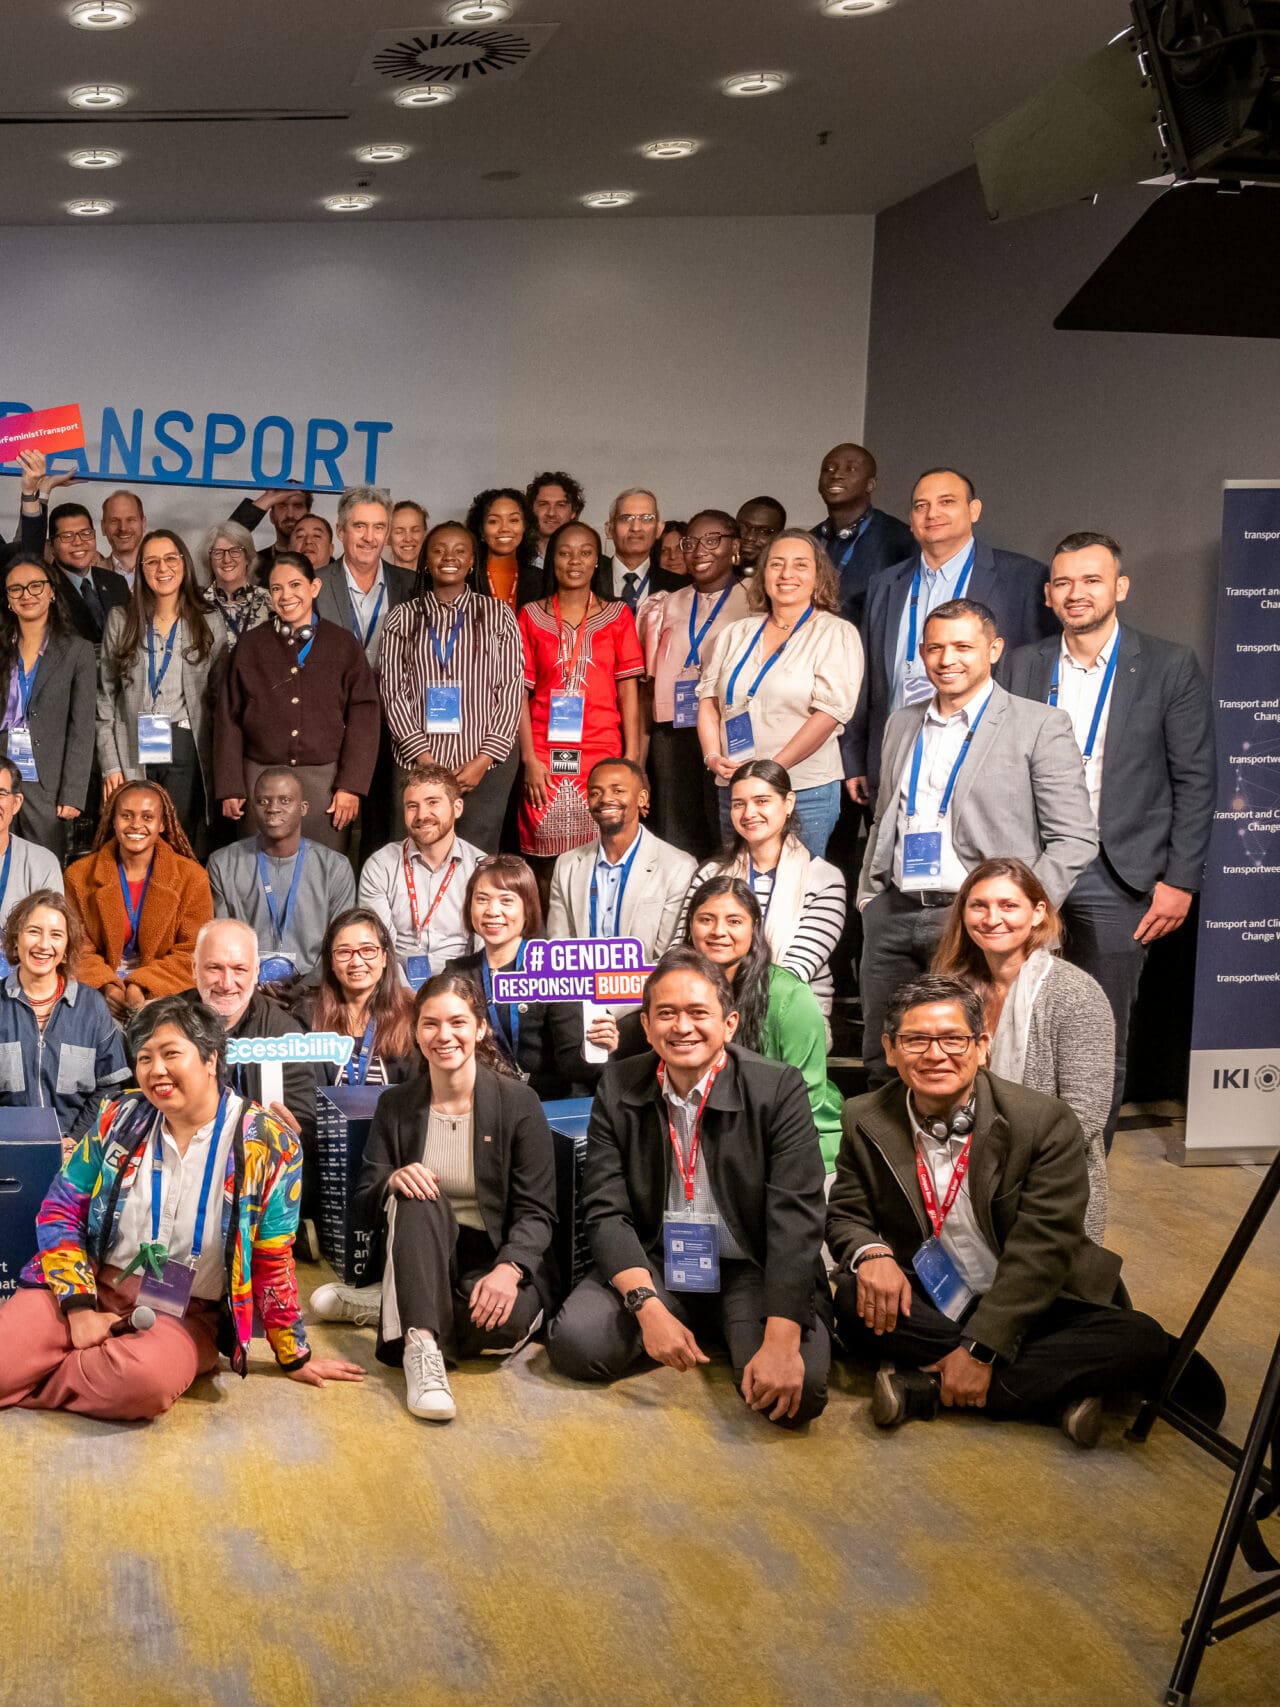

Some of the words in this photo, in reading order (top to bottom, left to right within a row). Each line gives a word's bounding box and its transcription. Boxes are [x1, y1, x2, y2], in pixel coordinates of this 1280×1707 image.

[1226, 587, 1266, 598] Transport
[1260, 600, 1280, 608] Cha
[1218, 700, 1260, 710] Transport
[1261, 699, 1279, 708] and
[1255, 810, 1272, 818] and
[1223, 864, 1280, 875] transportwee
[1205, 920, 1247, 930] Transport
[1248, 919, 1266, 928] and
[1242, 932, 1274, 942] Change
[530, 946, 544, 972] #
[550, 943, 639, 971] GENDER
[1216, 972, 1280, 984] transportweek
[499, 976, 594, 997] RESPONSIVE
[226, 1038, 350, 1059] ccessibility
[1213, 1068, 1250, 1089] IKI
[354, 1250, 369, 1258] an
